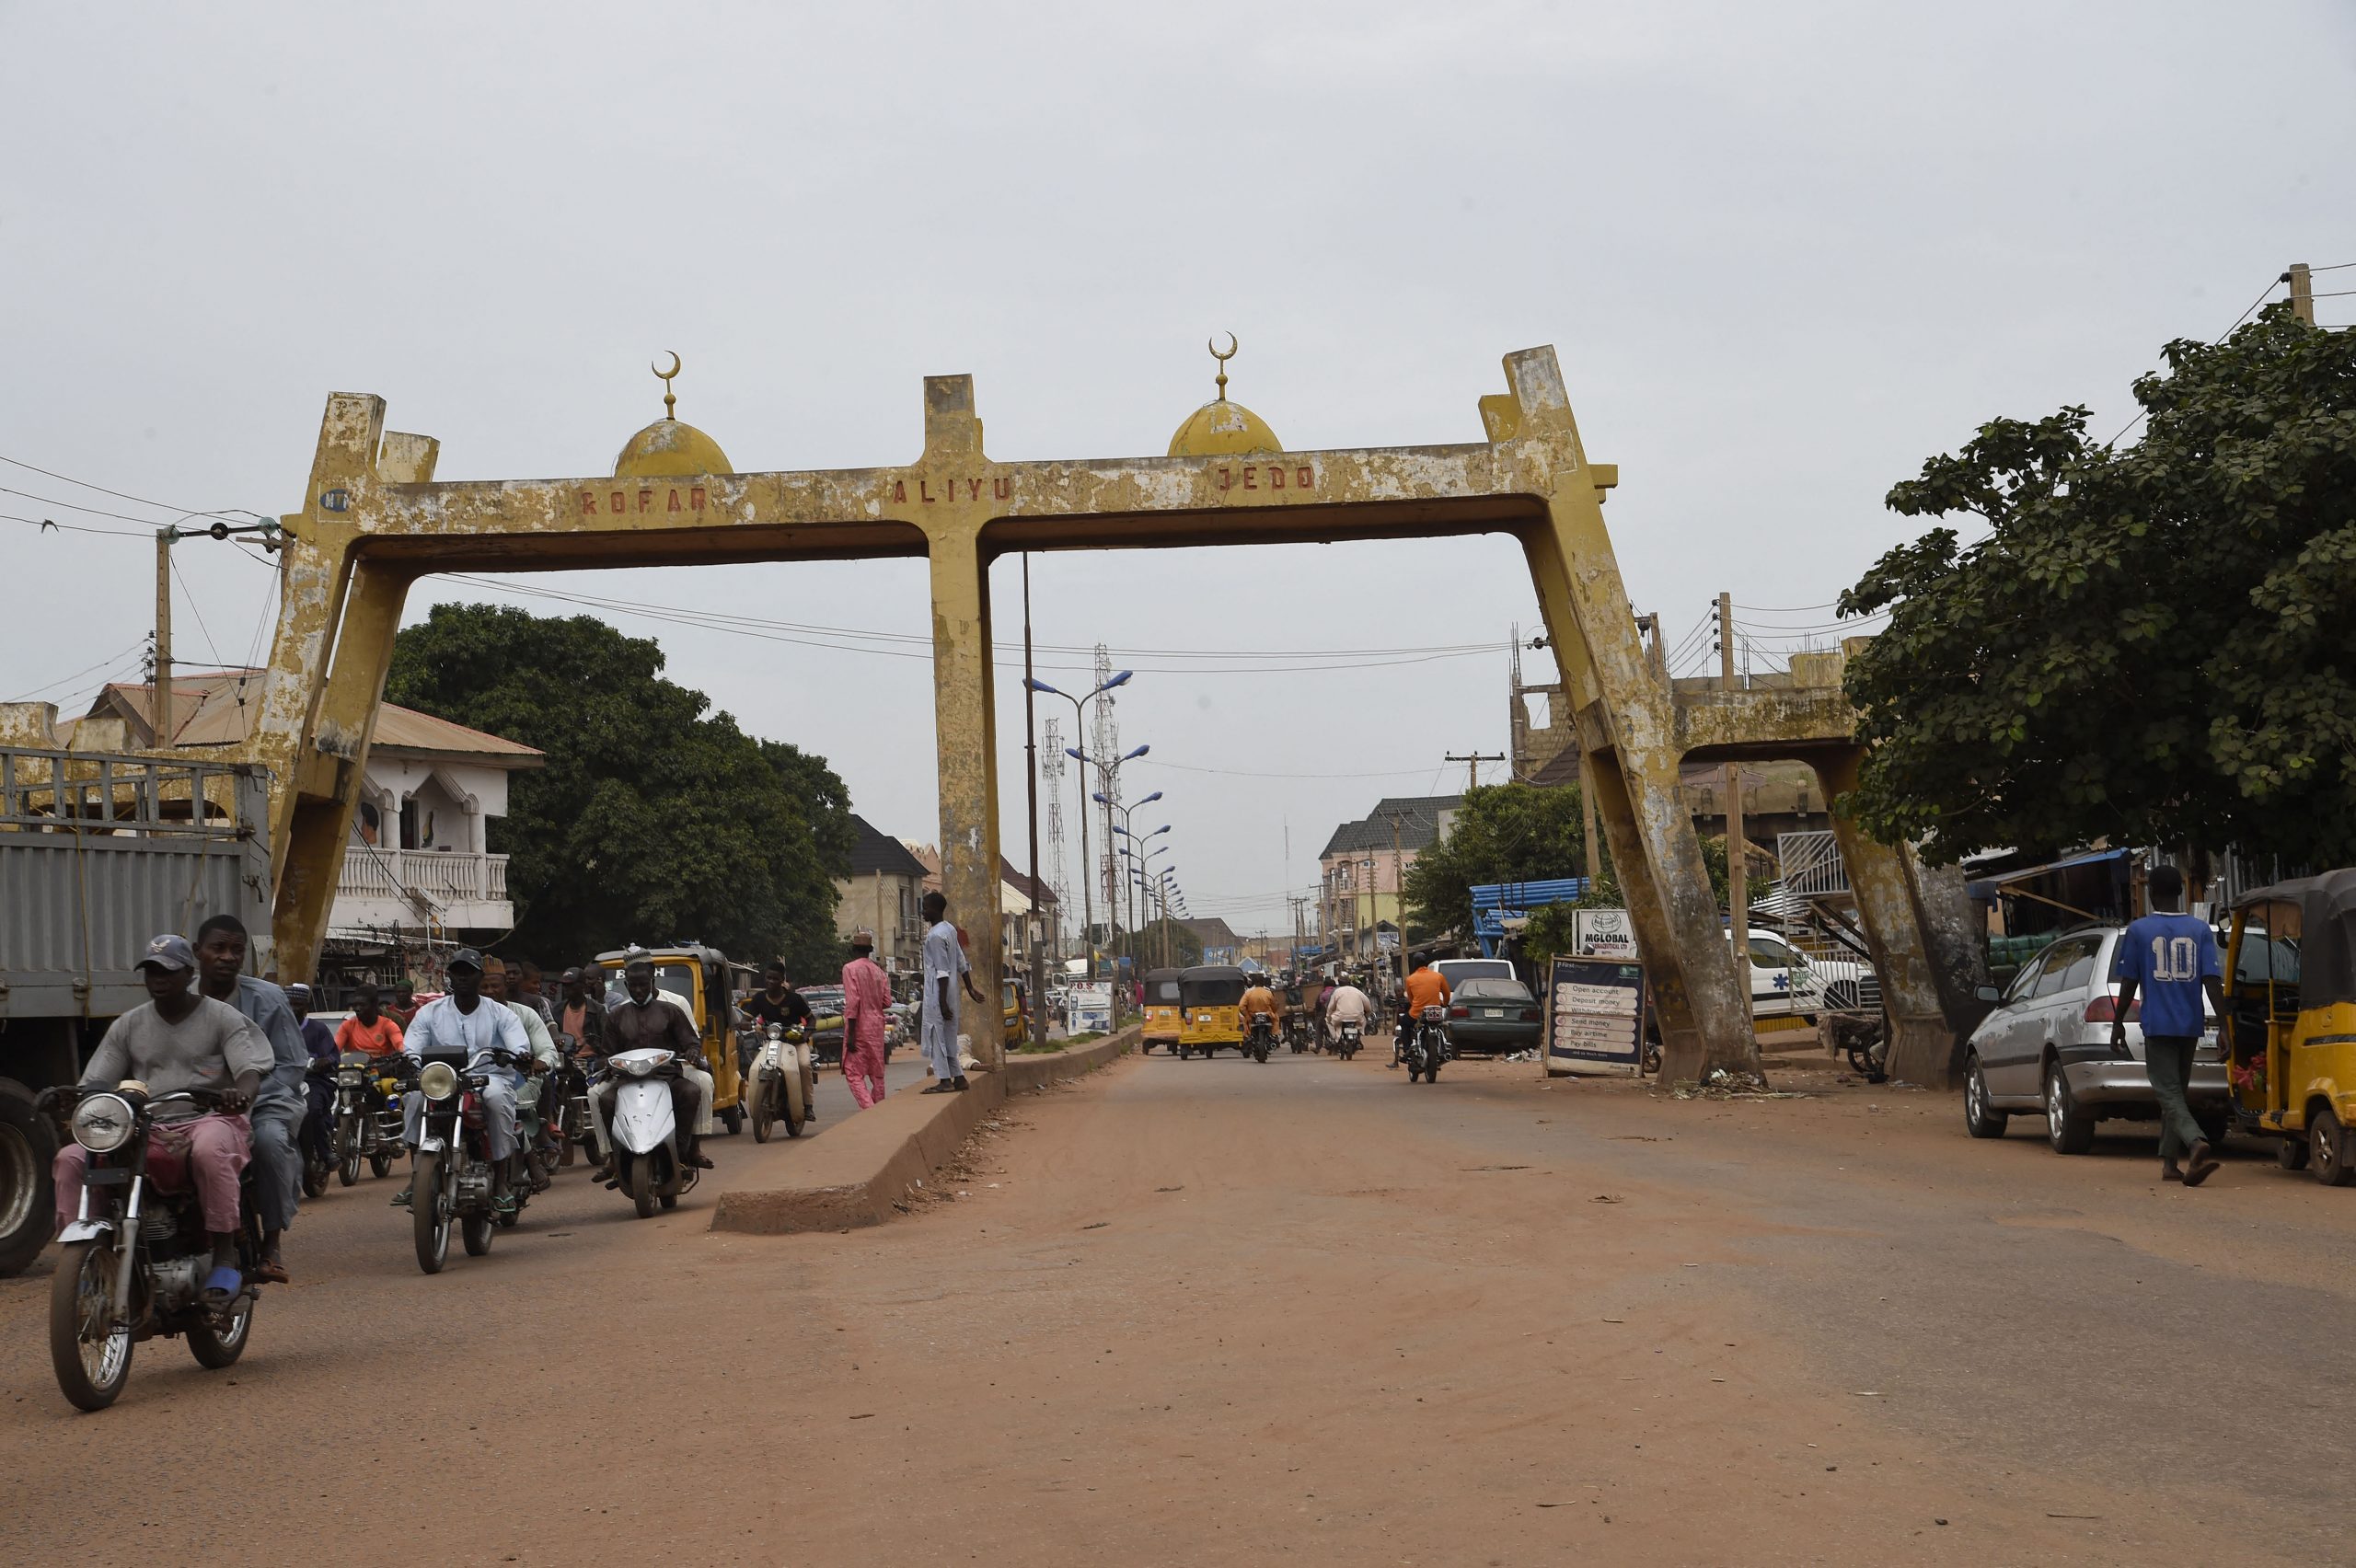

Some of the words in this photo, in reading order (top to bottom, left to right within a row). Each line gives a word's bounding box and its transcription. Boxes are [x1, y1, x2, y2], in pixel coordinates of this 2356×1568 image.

[893, 478, 1010, 503] ALIYU
[1218, 467, 1313, 491] JEDO
[1585, 933, 1629, 943] MGLOBAL
[2152, 936, 2197, 982] 10
[1573, 986, 1590, 994] Open
